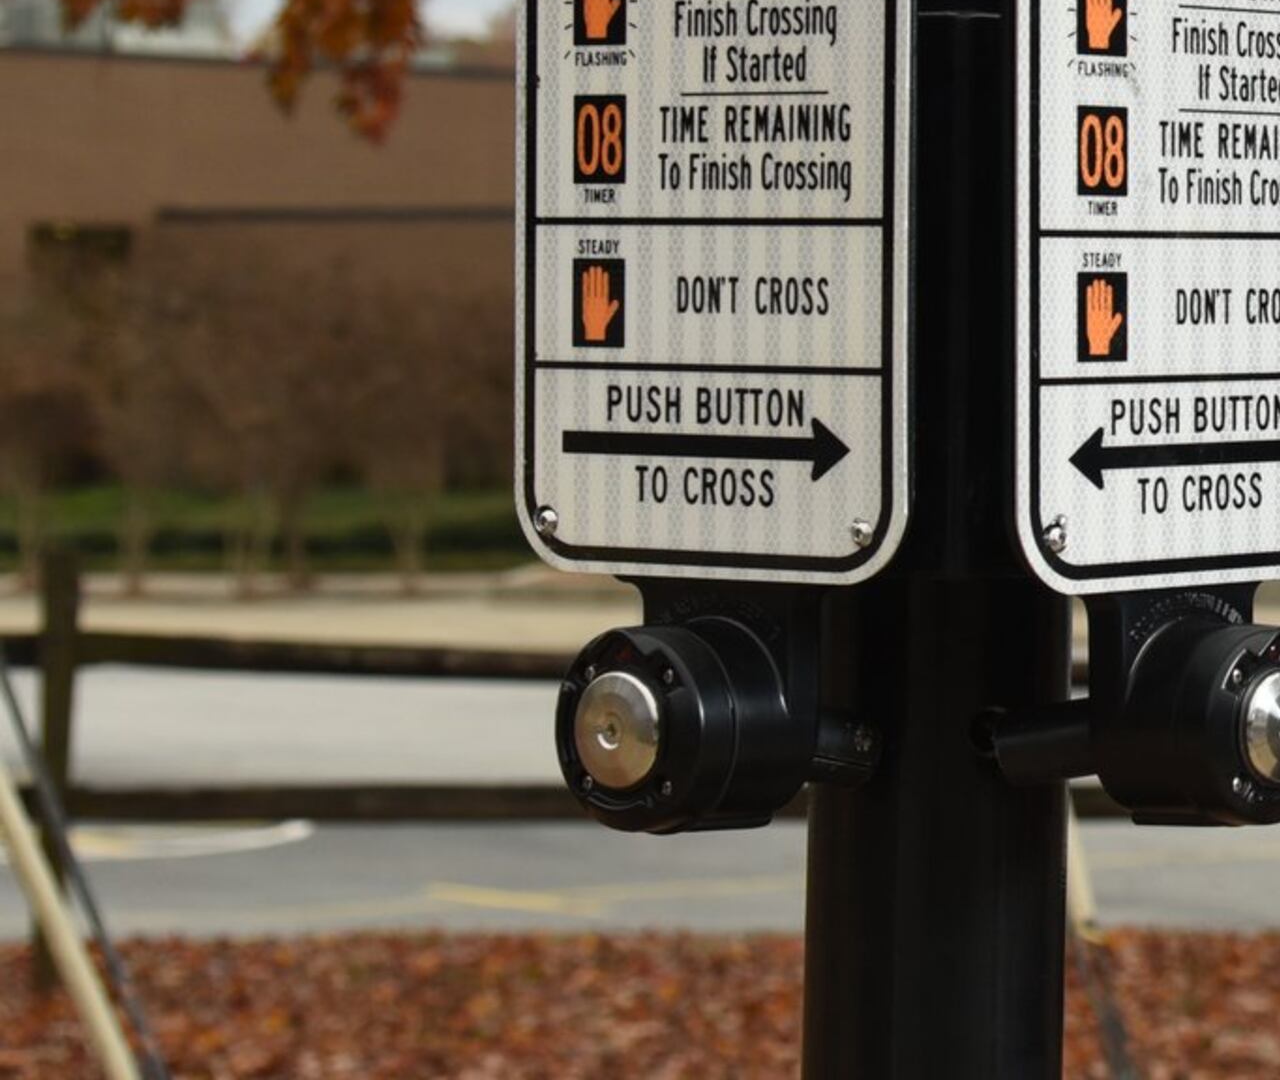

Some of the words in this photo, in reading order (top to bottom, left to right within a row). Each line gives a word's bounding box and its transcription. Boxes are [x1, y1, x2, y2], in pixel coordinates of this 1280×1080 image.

[1172, 17, 1229, 57] Finish
[575, 51, 627, 66] FLASHING
[703, 47, 717, 84] If
[726, 46, 807, 83] Started
[1078, 61, 1129, 78] FLASHING
[1199, 65, 1211, 101] If
[577, 103, 623, 176] 08
[660, 105, 709, 143] TIME
[725, 103, 852, 143] REMAINING
[1159, 120, 1205, 159] TIME
[1080, 113, 1125, 189] 08
[583, 188, 616, 204] TIMER
[658, 153, 680, 191] To
[689, 153, 752, 191] Finish
[760, 152, 852, 203] Crossing
[1159, 167, 1178, 205] To
[1186, 168, 1243, 206] Finish
[1088, 200, 1118, 216] TIMER
[578, 239, 620, 255] STEADY
[1082, 252, 1122, 268] STEADY
[676, 276, 740, 315] DON'T
[754, 276, 830, 316] CROSS
[1176, 289, 1231, 325] DON'T
[606, 384, 682, 424] PUSH
[696, 388, 805, 427] BUTTON
[1111, 398, 1181, 437] PUSH
[635, 466, 668, 504] TO
[683, 467, 775, 508] CROSS
[1137, 477, 1168, 515] TO
[1182, 473, 1263, 512] CROSS
